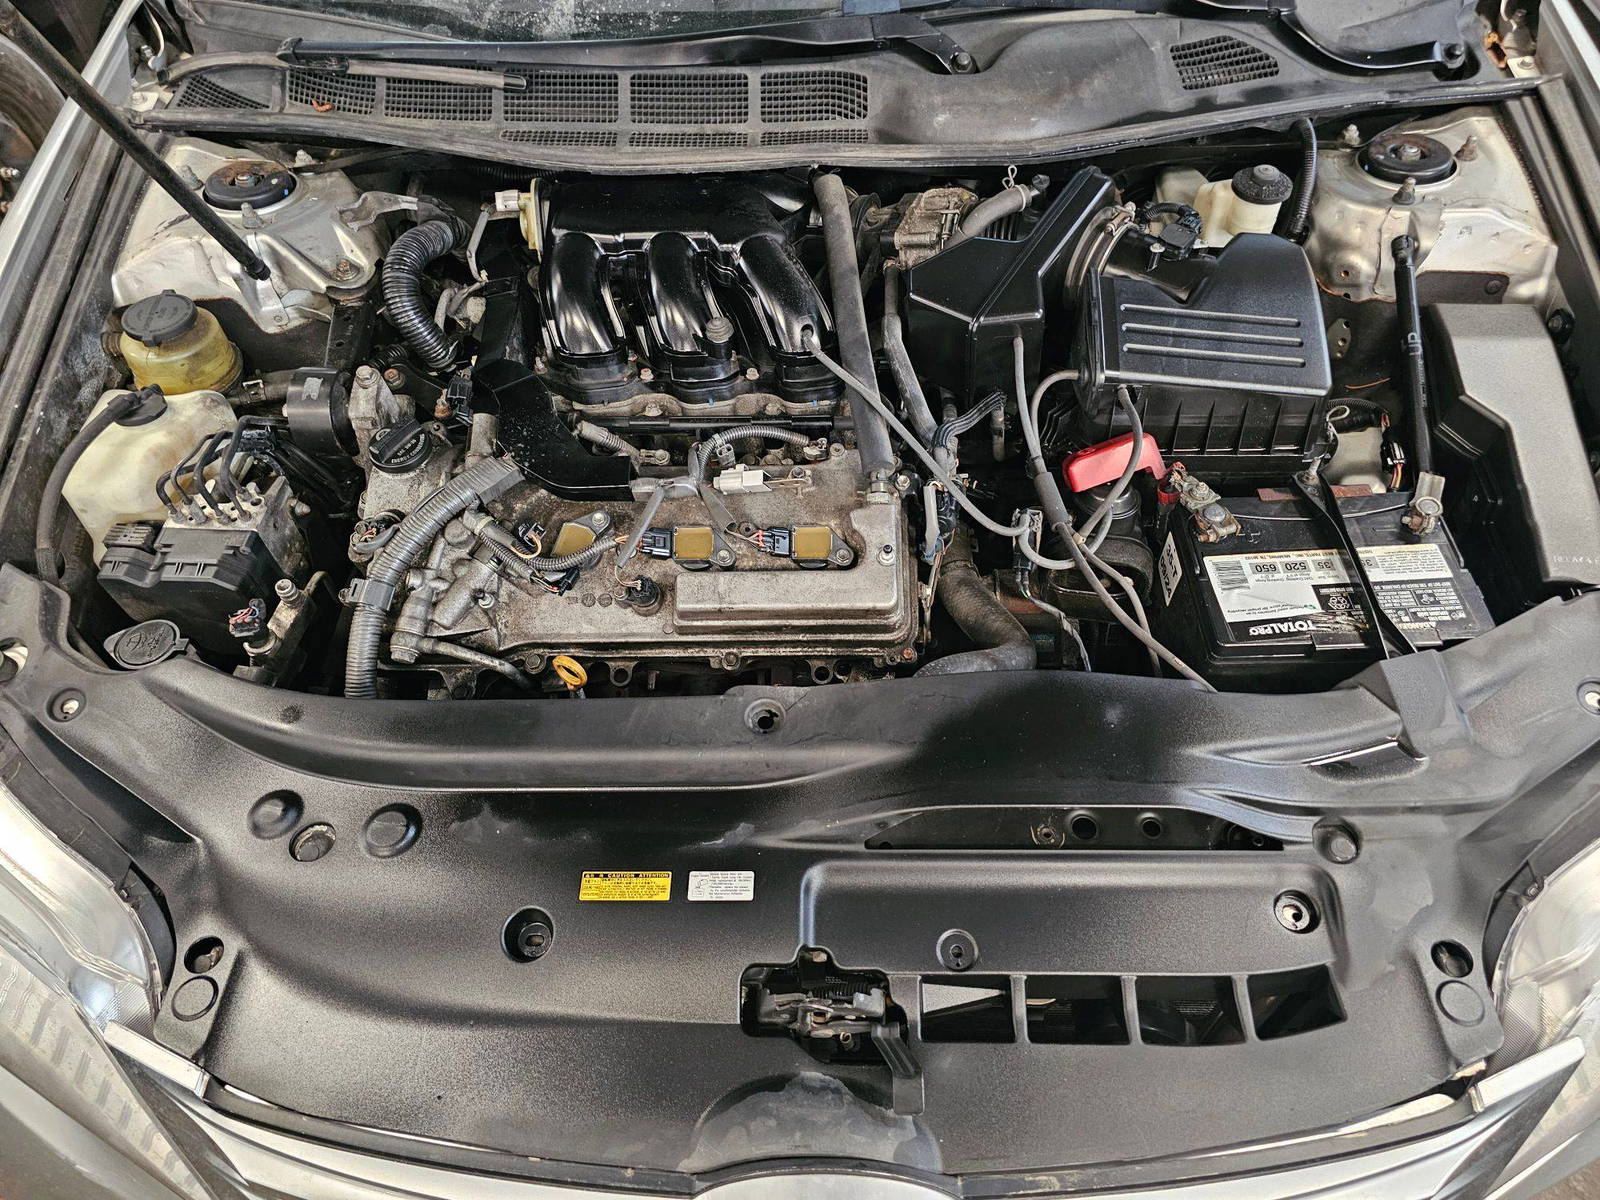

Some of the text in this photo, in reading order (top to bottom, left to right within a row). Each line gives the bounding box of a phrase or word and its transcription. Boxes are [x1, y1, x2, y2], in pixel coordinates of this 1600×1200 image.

[1255, 562, 1277, 573] 650
[1284, 561, 1307, 571] 520
[1317, 561, 1331, 570] 35
[1249, 620, 1315, 636] TOTALPRO
